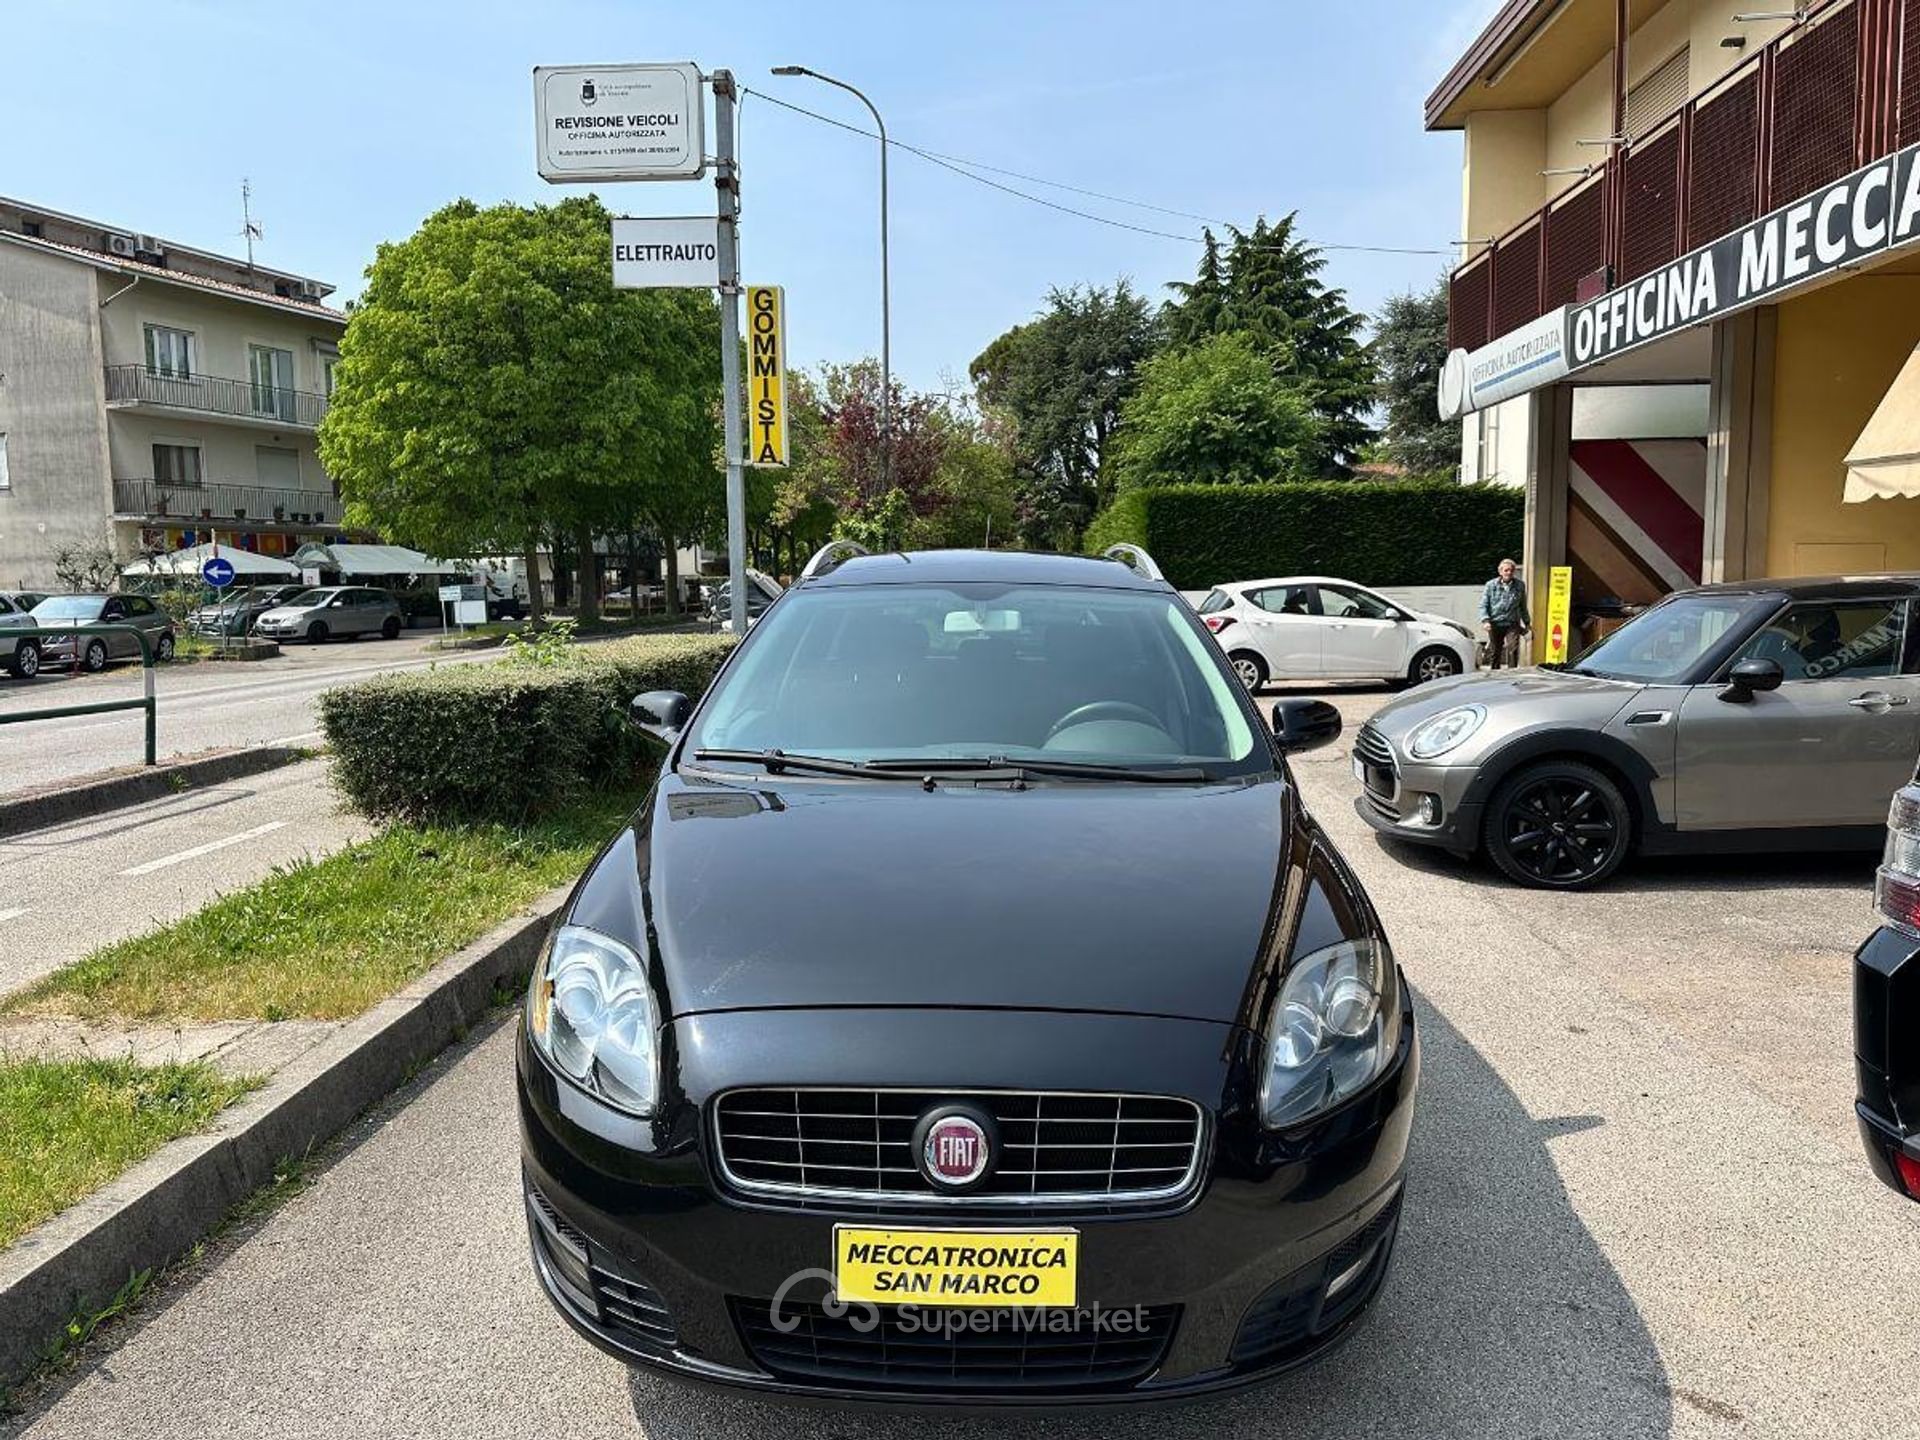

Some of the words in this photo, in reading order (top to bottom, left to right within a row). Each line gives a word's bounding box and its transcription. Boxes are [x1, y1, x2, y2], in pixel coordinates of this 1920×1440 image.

[555, 115, 624, 129] REVISIONE
[627, 114, 679, 126] VEICOLI
[568, 131, 607, 140] OFFICINA
[608, 129, 667, 139] AUTORIZZATA
[616, 244, 716, 261] ELETTRAUTO
[1575, 250, 1718, 361] OFFICINA
[1471, 354, 1506, 382] OFFICINA
[1506, 328, 1561, 368] AUTORIZZATA
[753, 289, 777, 464] GOMMISTA
[940, 1137, 976, 1167] FIAT
[847, 1243, 1067, 1269] MECCATRONICA
[874, 1271, 932, 1293] SAN
[940, 1273, 1039, 1296] MARCO
